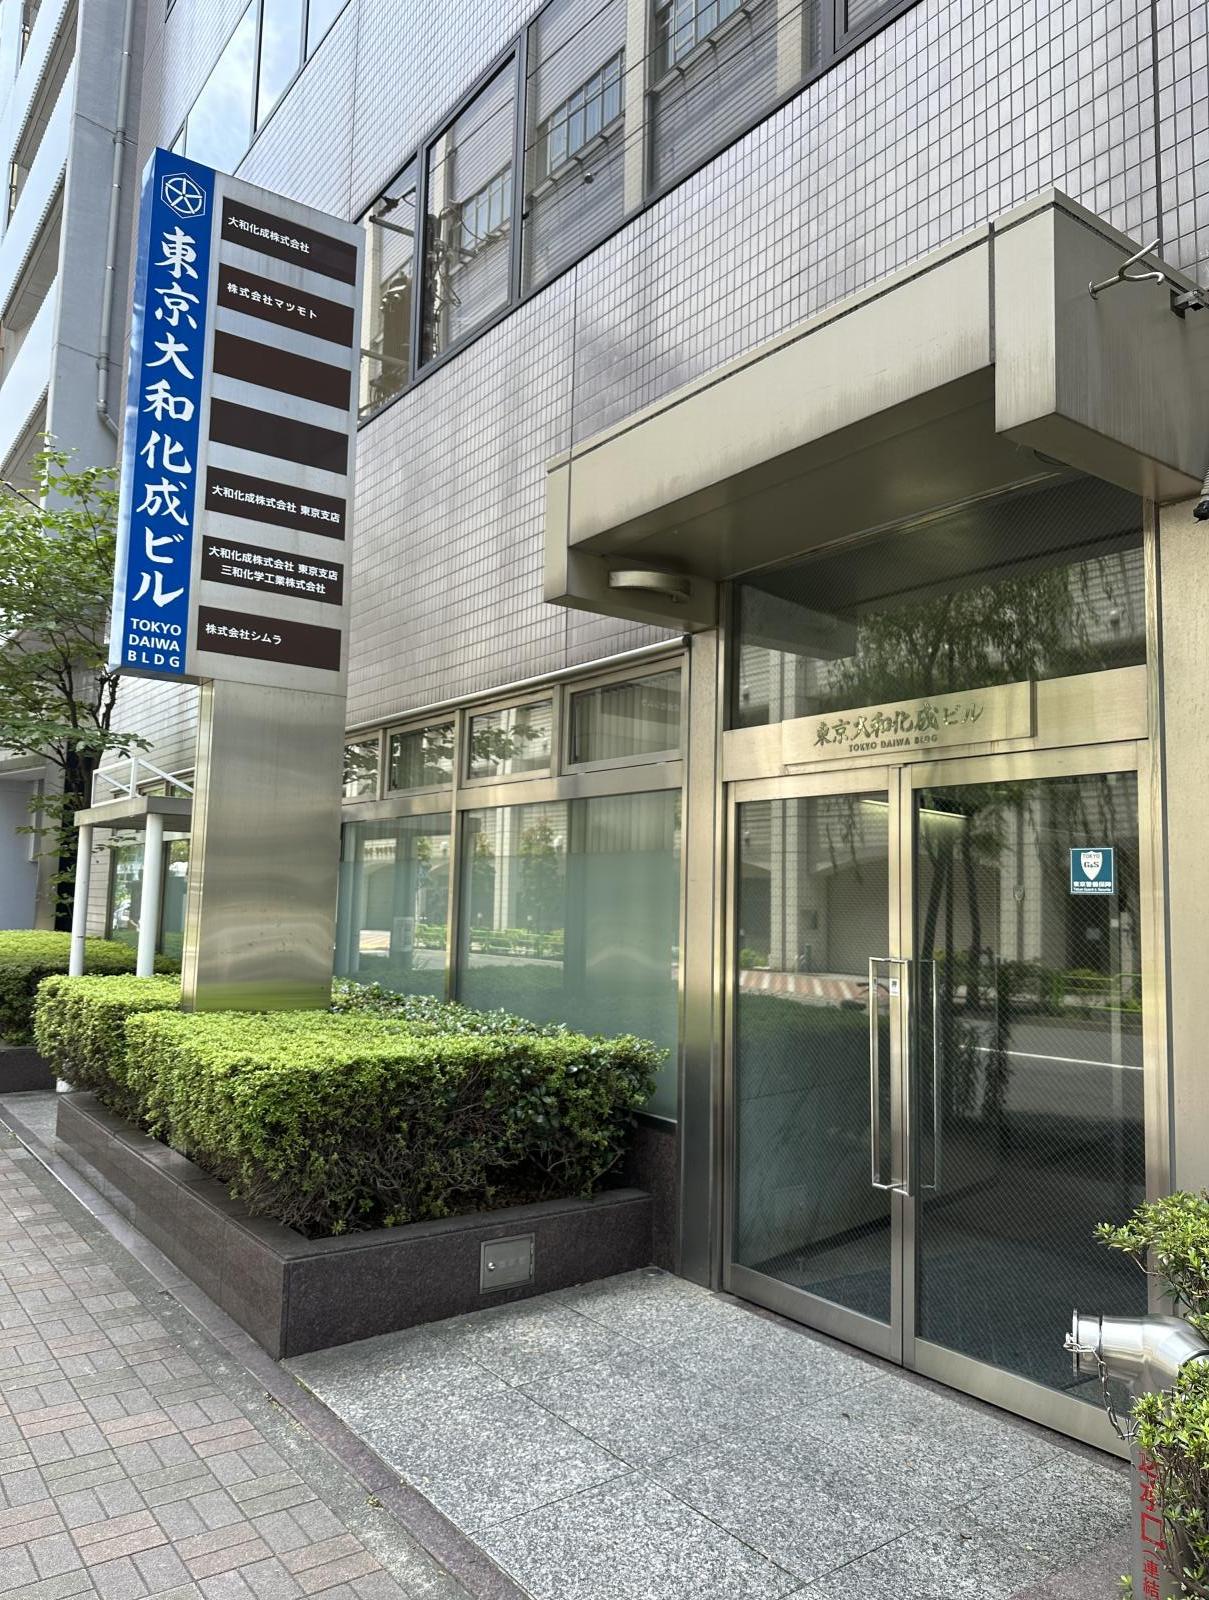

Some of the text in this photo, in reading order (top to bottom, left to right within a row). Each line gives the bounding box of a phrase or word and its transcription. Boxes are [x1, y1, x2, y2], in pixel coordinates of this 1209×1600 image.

[227, 216, 310, 254] 大和化成株式会社
[226, 282, 318, 320] 株式会社マツモト
[132, 226, 199, 607] 東京大和化成ビル
[211, 485, 340, 523] 大和化成株式会社 東京支店
[208, 546, 338, 581] 大和化成株式会社 東京支店
[220, 564, 326, 594] 三和化学工業株式会社
[128, 634, 180, 651] DAIWA
[130, 618, 182, 636] TOKYO
[205, 623, 282, 645] 株式会社シムラ
[127, 650, 180, 667] BLDG
[813, 703, 984, 747] 東京大和化成ビル
[849, 734, 938, 752] TOKYO DAIWA BLDG
